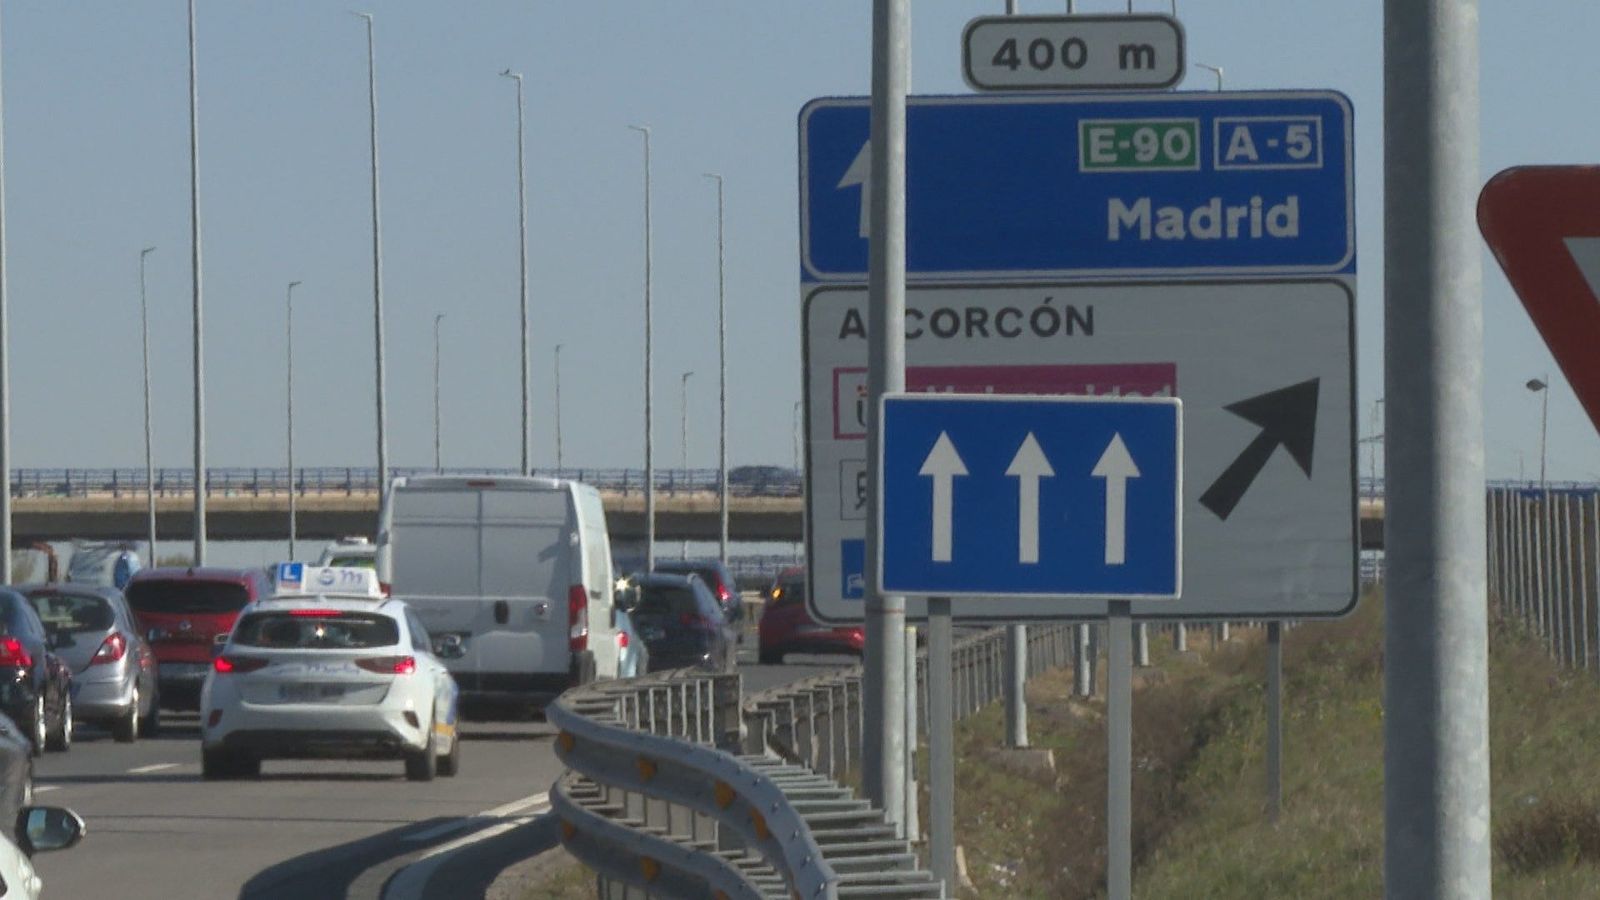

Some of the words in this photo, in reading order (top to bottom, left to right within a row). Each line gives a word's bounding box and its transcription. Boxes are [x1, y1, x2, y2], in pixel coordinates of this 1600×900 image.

[992, 37, 1088, 71] 400
[1118, 43, 1156, 70] m
[1089, 126, 1192, 163] E-90
[1107, 195, 1299, 240] Madrid
[838, 297, 1094, 340] ACORCÓN
[283, 564, 297, 580] L
